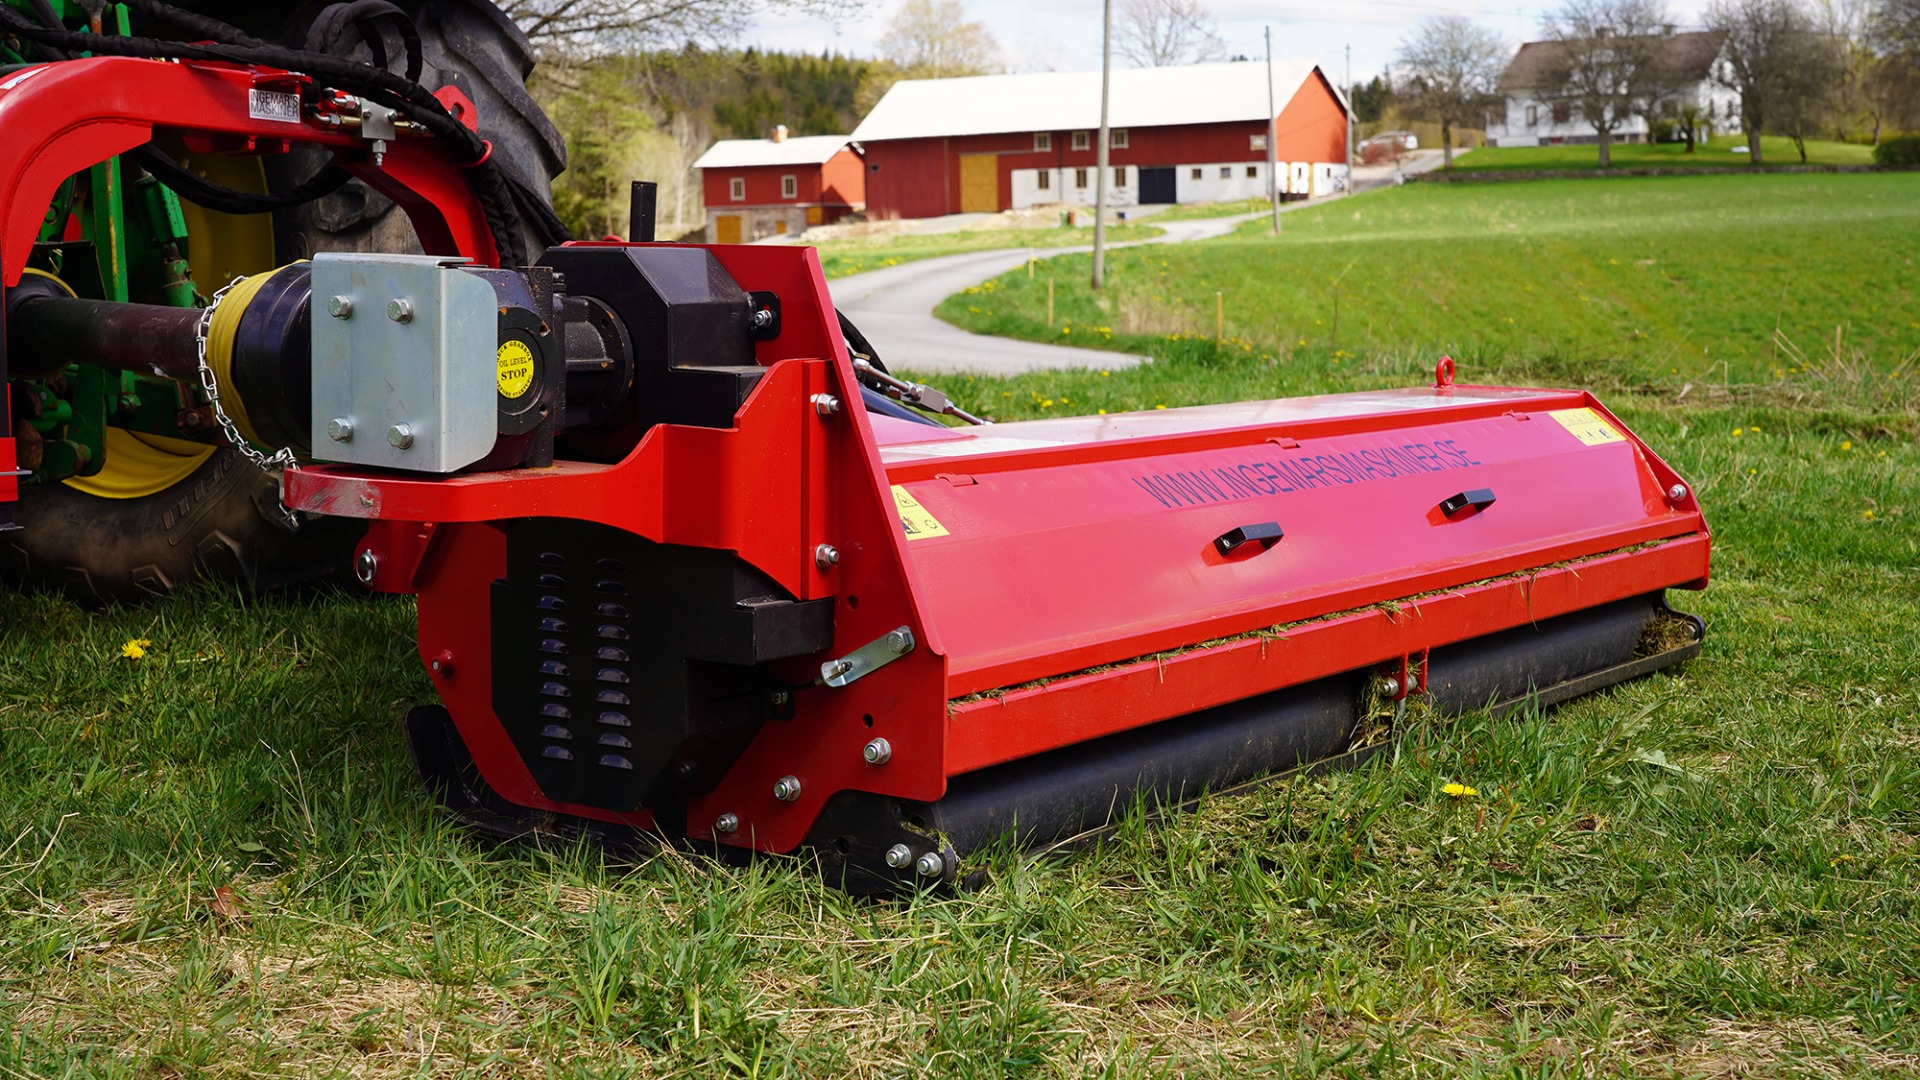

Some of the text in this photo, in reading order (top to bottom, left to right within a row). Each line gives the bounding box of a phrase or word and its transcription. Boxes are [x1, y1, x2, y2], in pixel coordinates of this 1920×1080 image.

[250, 91, 299, 107] INGEMAR'S
[250, 102, 299, 117] MASKINER
[499, 356, 527, 368] OIL LEVEL
[501, 368, 527, 381] STOP
[1131, 440, 1482, 508] WWW.INGEMARSMASKINER.SE
